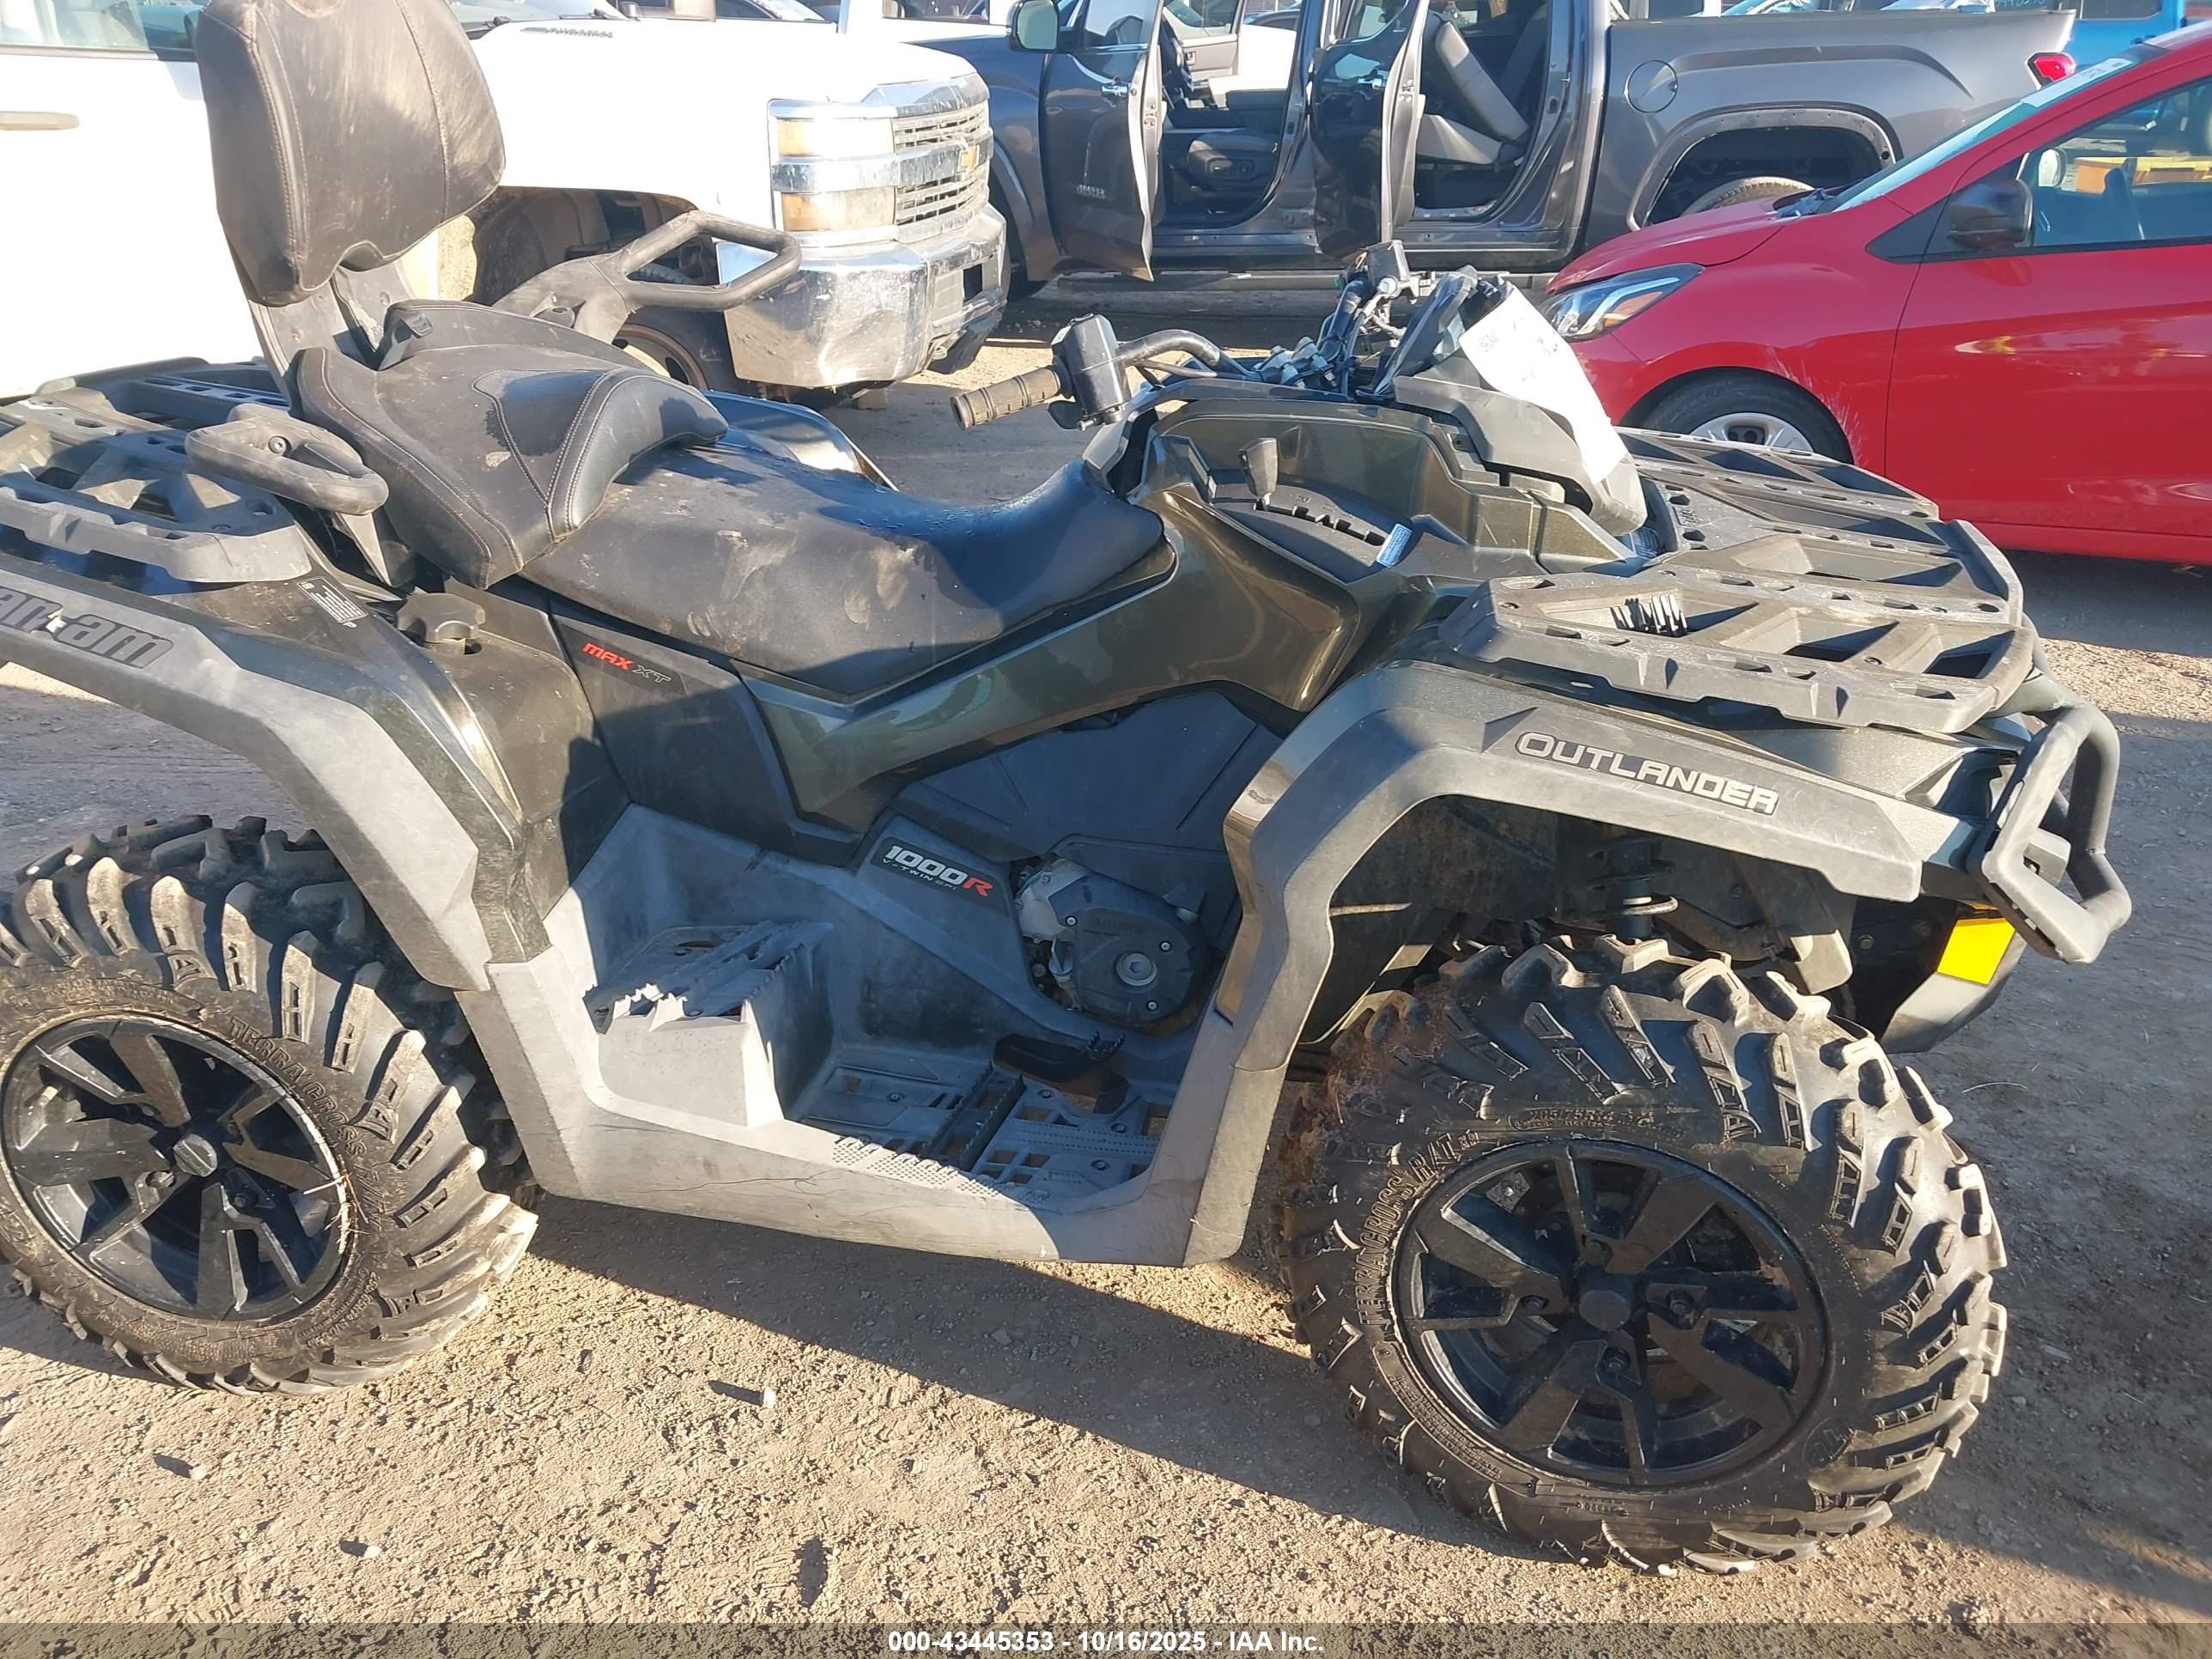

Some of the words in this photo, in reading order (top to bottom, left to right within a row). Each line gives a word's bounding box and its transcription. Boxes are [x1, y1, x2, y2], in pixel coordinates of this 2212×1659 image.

[582, 641, 634, 670] MAX
[631, 664, 672, 684] XT
[1517, 732, 1779, 815] OUTLANDER
[884, 845, 994, 896] 1000R
